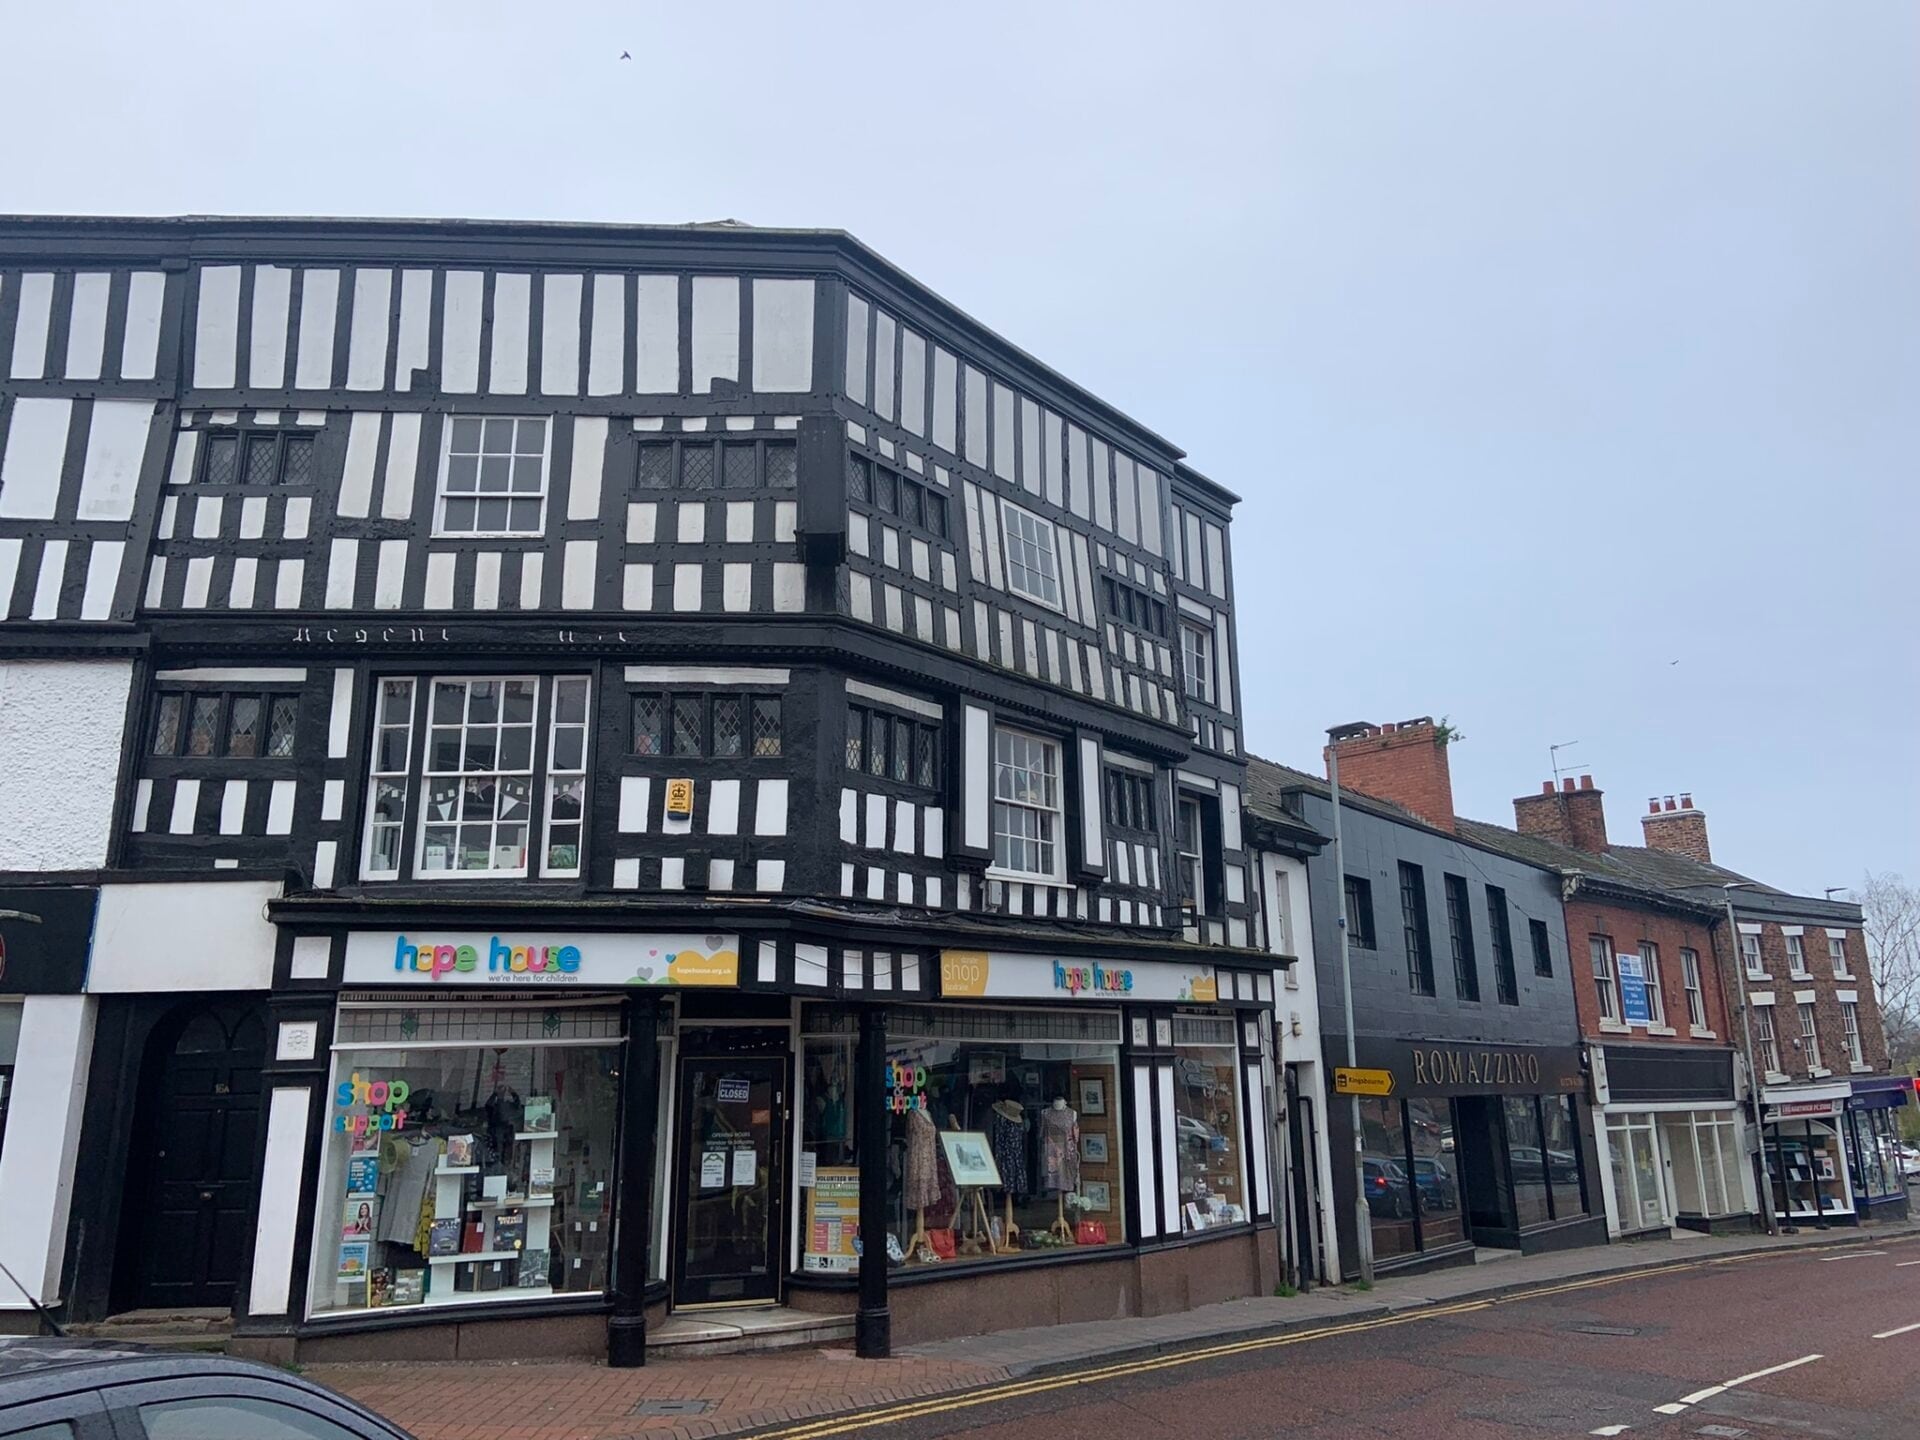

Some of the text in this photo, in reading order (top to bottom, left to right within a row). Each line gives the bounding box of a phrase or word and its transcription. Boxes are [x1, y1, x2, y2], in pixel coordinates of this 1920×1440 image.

[395, 935, 581, 982] hope house
[677, 967, 731, 975] hopehouse.org.uk
[943, 958, 980, 985] shop
[488, 974, 578, 983] we're here for children
[1053, 960, 1133, 996] hope house
[886, 1060, 926, 1094] shop
[1413, 1049, 1539, 1084] ROMAZZINO
[337, 1072, 409, 1112] shop
[720, 1089, 748, 1099] CLOSED
[886, 1091, 927, 1114] support
[893, 1081, 904, 1097] &
[335, 1109, 407, 1136] support
